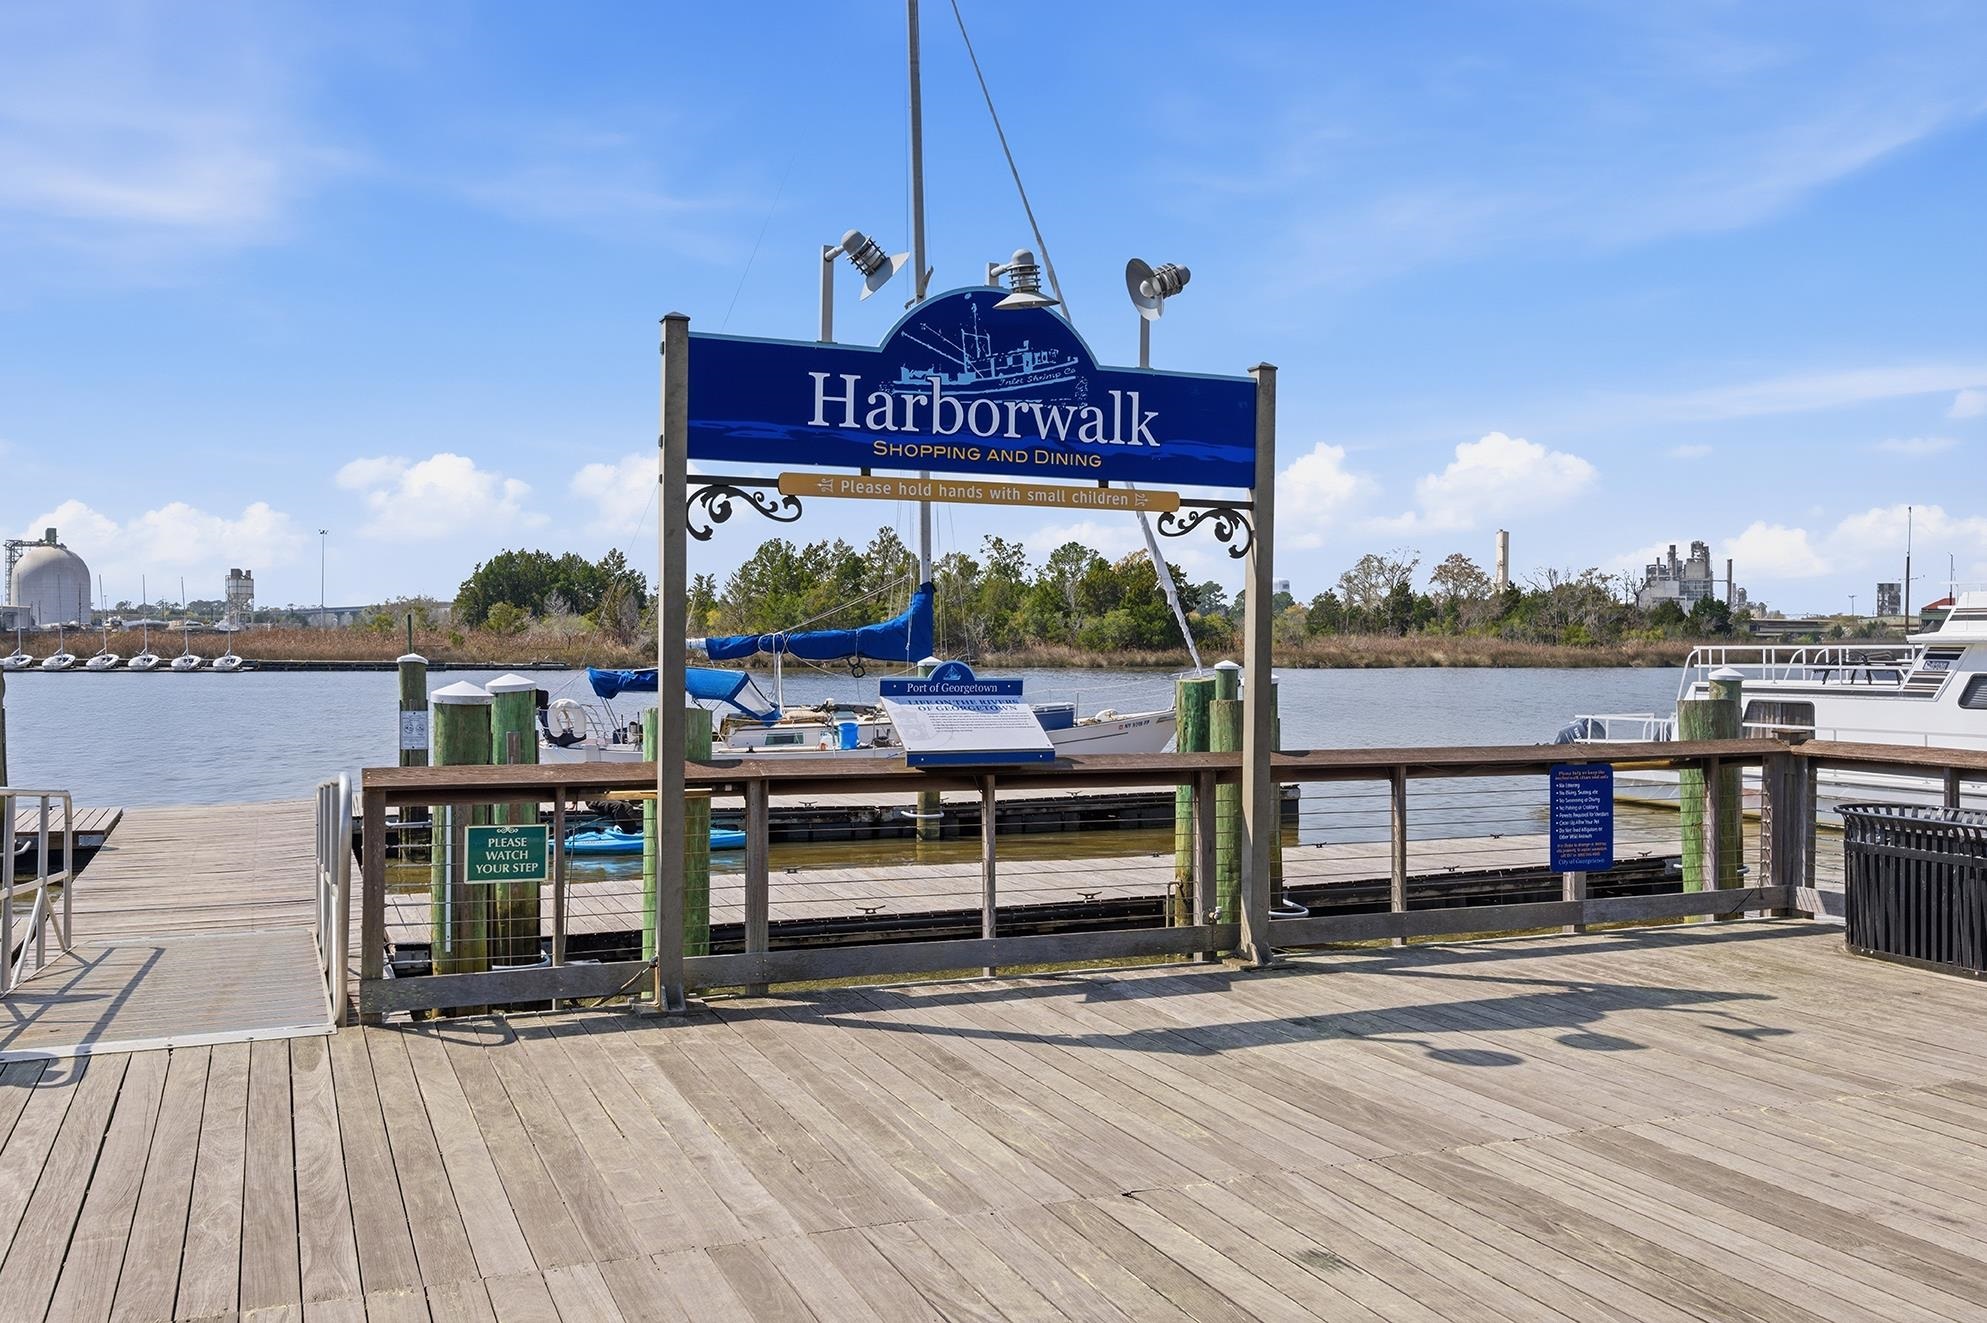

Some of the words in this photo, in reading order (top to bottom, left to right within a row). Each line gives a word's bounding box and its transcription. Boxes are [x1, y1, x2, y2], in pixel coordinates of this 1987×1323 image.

[999, 375, 1024, 386] Inlet
[1026, 372, 1062, 383] Shrimp
[807, 371, 1161, 448] Harborwalk
[873, 440, 982, 461] SHOPPING
[986, 449, 1029, 464] AND
[1034, 450, 1102, 468] DINING
[840, 479, 892, 495] Please
[898, 482, 932, 497] hold
[939, 484, 983, 499] hands
[989, 487, 1021, 501] with
[1027, 490, 1066, 503] small
[1071, 491, 1128, 506] children
[906, 683, 927, 693] Port
[929, 682, 940, 693] of
[941, 683, 998, 694] Georgetown
[487, 836, 528, 849] PLEASE
[485, 850, 529, 862] WATCH
[475, 862, 510, 874] YOUR
[512, 862, 539, 873] STEP
